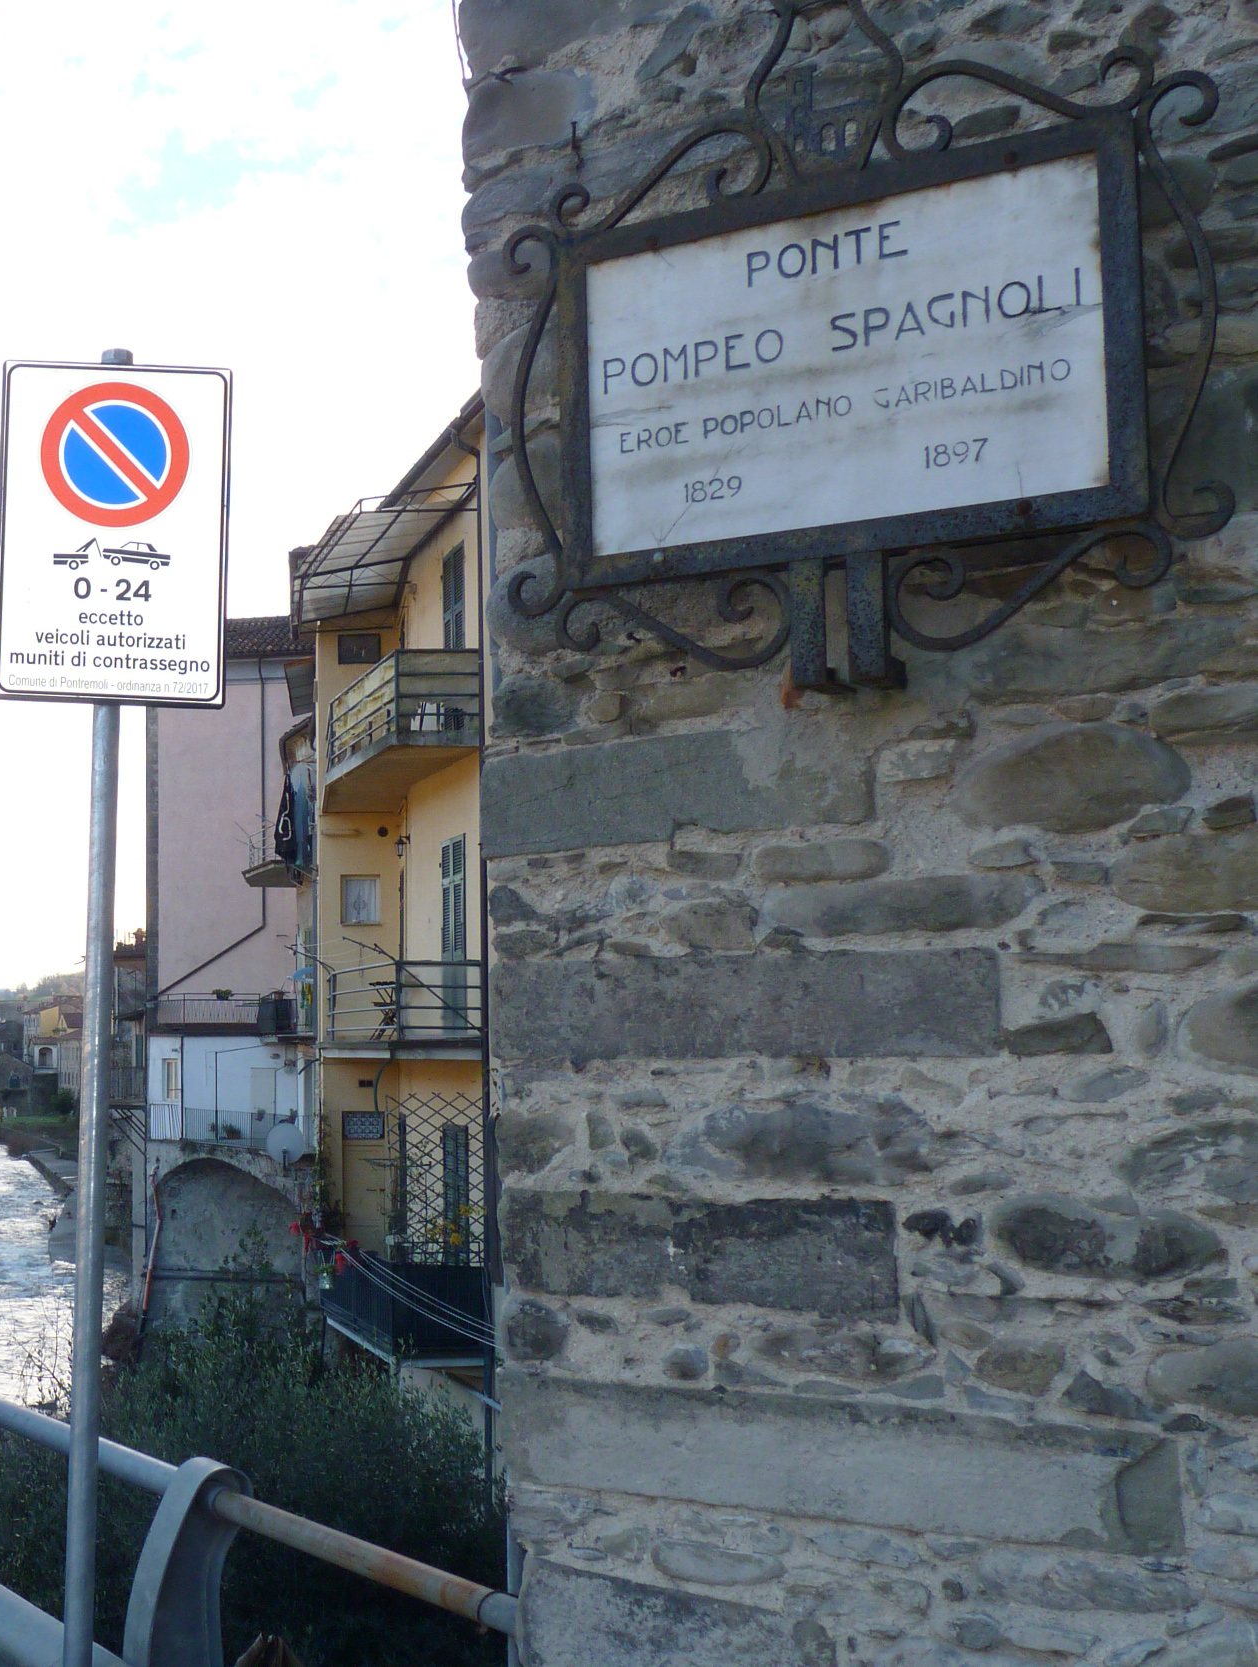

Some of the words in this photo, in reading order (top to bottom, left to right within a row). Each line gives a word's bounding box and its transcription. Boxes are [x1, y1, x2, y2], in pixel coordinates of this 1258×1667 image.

[747, 220, 908, 288] PONTE
[602, 328, 784, 395] POMPEO
[829, 267, 1083, 352] SPAGNOLI
[619, 421, 690, 454] EROE
[702, 395, 852, 440] POPOLANO
[873, 358, 1072, 409] GARIBALDINO
[683, 475, 743, 503] 1829
[923, 437, 989, 470] 1897
[115, 578, 152, 602] 24
[78, 610, 144, 627] eccetto
[35, 628, 90, 646] veicoli
[96, 631, 186, 650] autorizzati
[9, 649, 65, 666] muniti
[71, 651, 87, 667] di
[92, 653, 210, 675] contrassegno
[8, 674, 47, 687] Comune
[49, 676, 58, 688] di
[60, 676, 109, 690] Pontremoli
[116, 680, 162, 693] ordinanza
